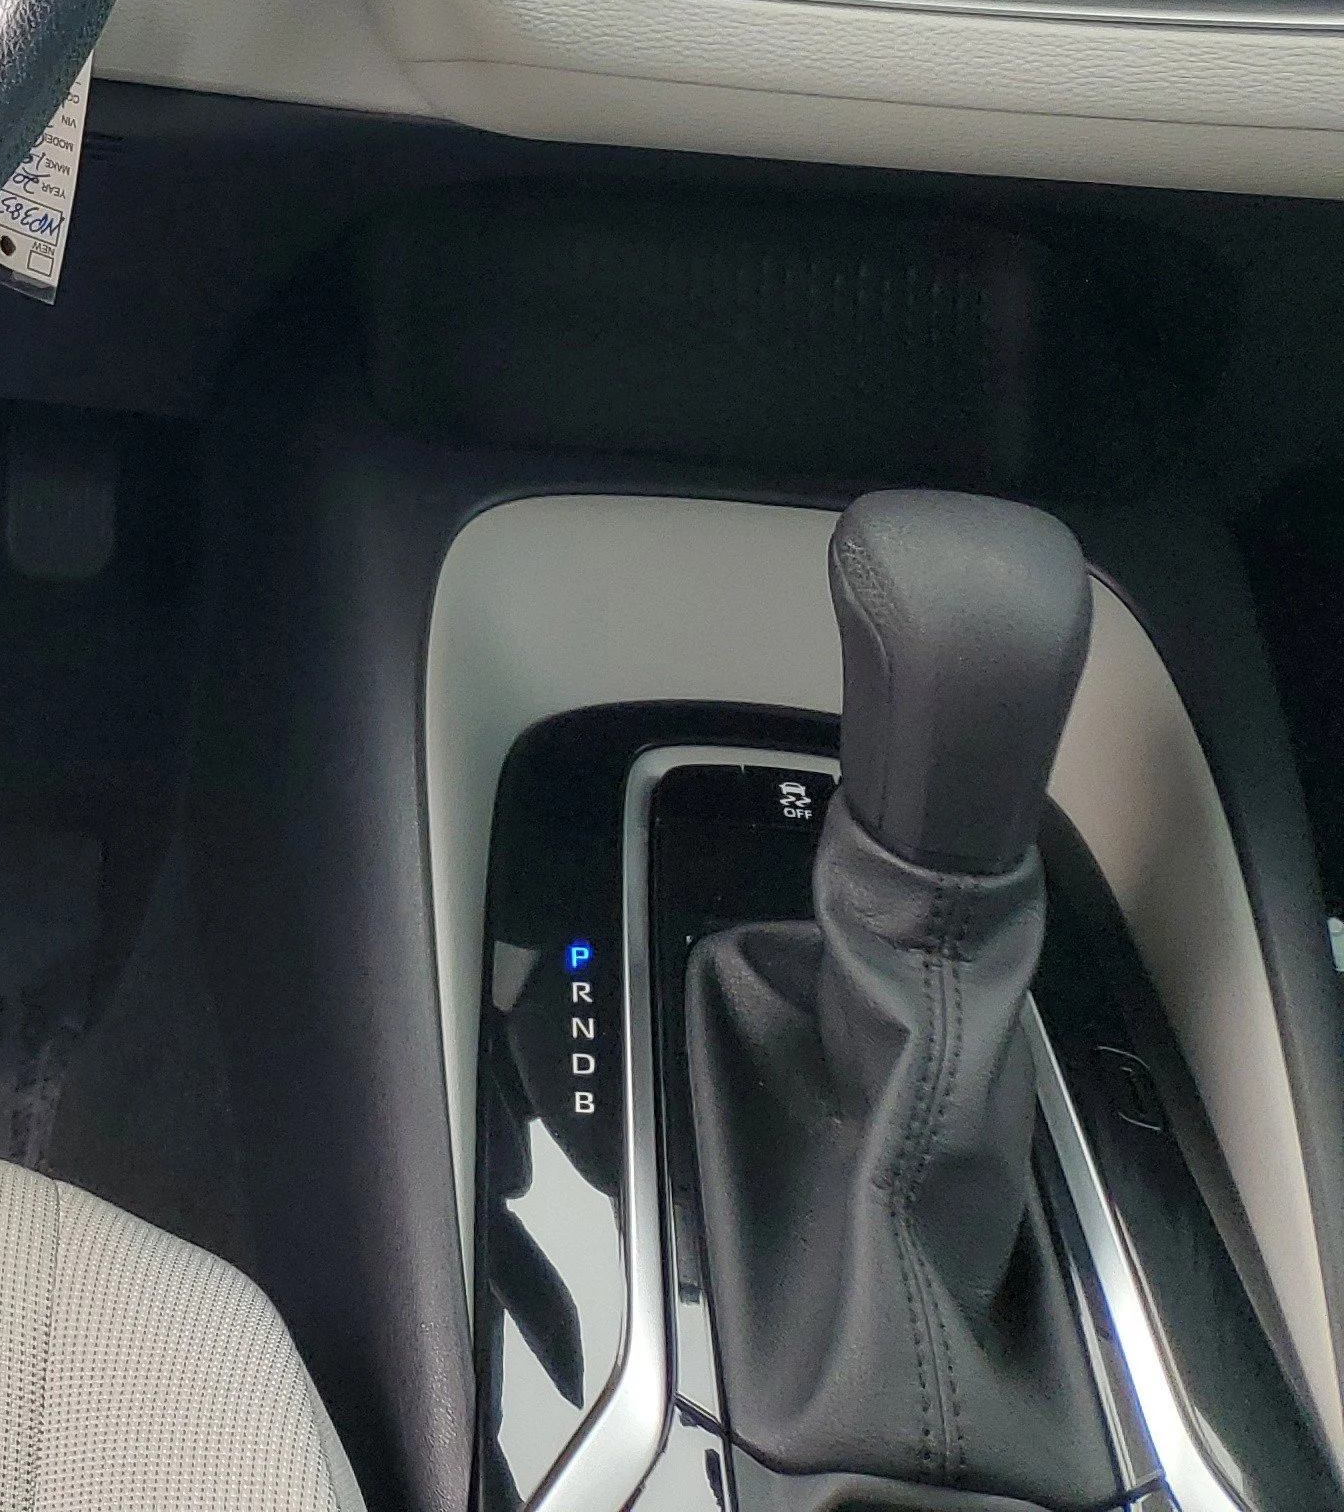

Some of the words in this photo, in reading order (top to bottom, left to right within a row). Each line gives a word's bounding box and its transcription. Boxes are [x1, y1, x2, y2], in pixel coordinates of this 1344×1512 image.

[61, 115, 77, 128] VIN
[45, 157, 70, 175] MAKE
[41, 183, 66, 199] YEAR
[31, 241, 56, 256] NEW
[783, 807, 813, 820] OFF
[571, 946, 590, 969] P
[572, 981, 594, 1004] R
[572, 1017, 596, 1040] N
[572, 1053, 597, 1075] D
[574, 1091, 596, 1114] B
